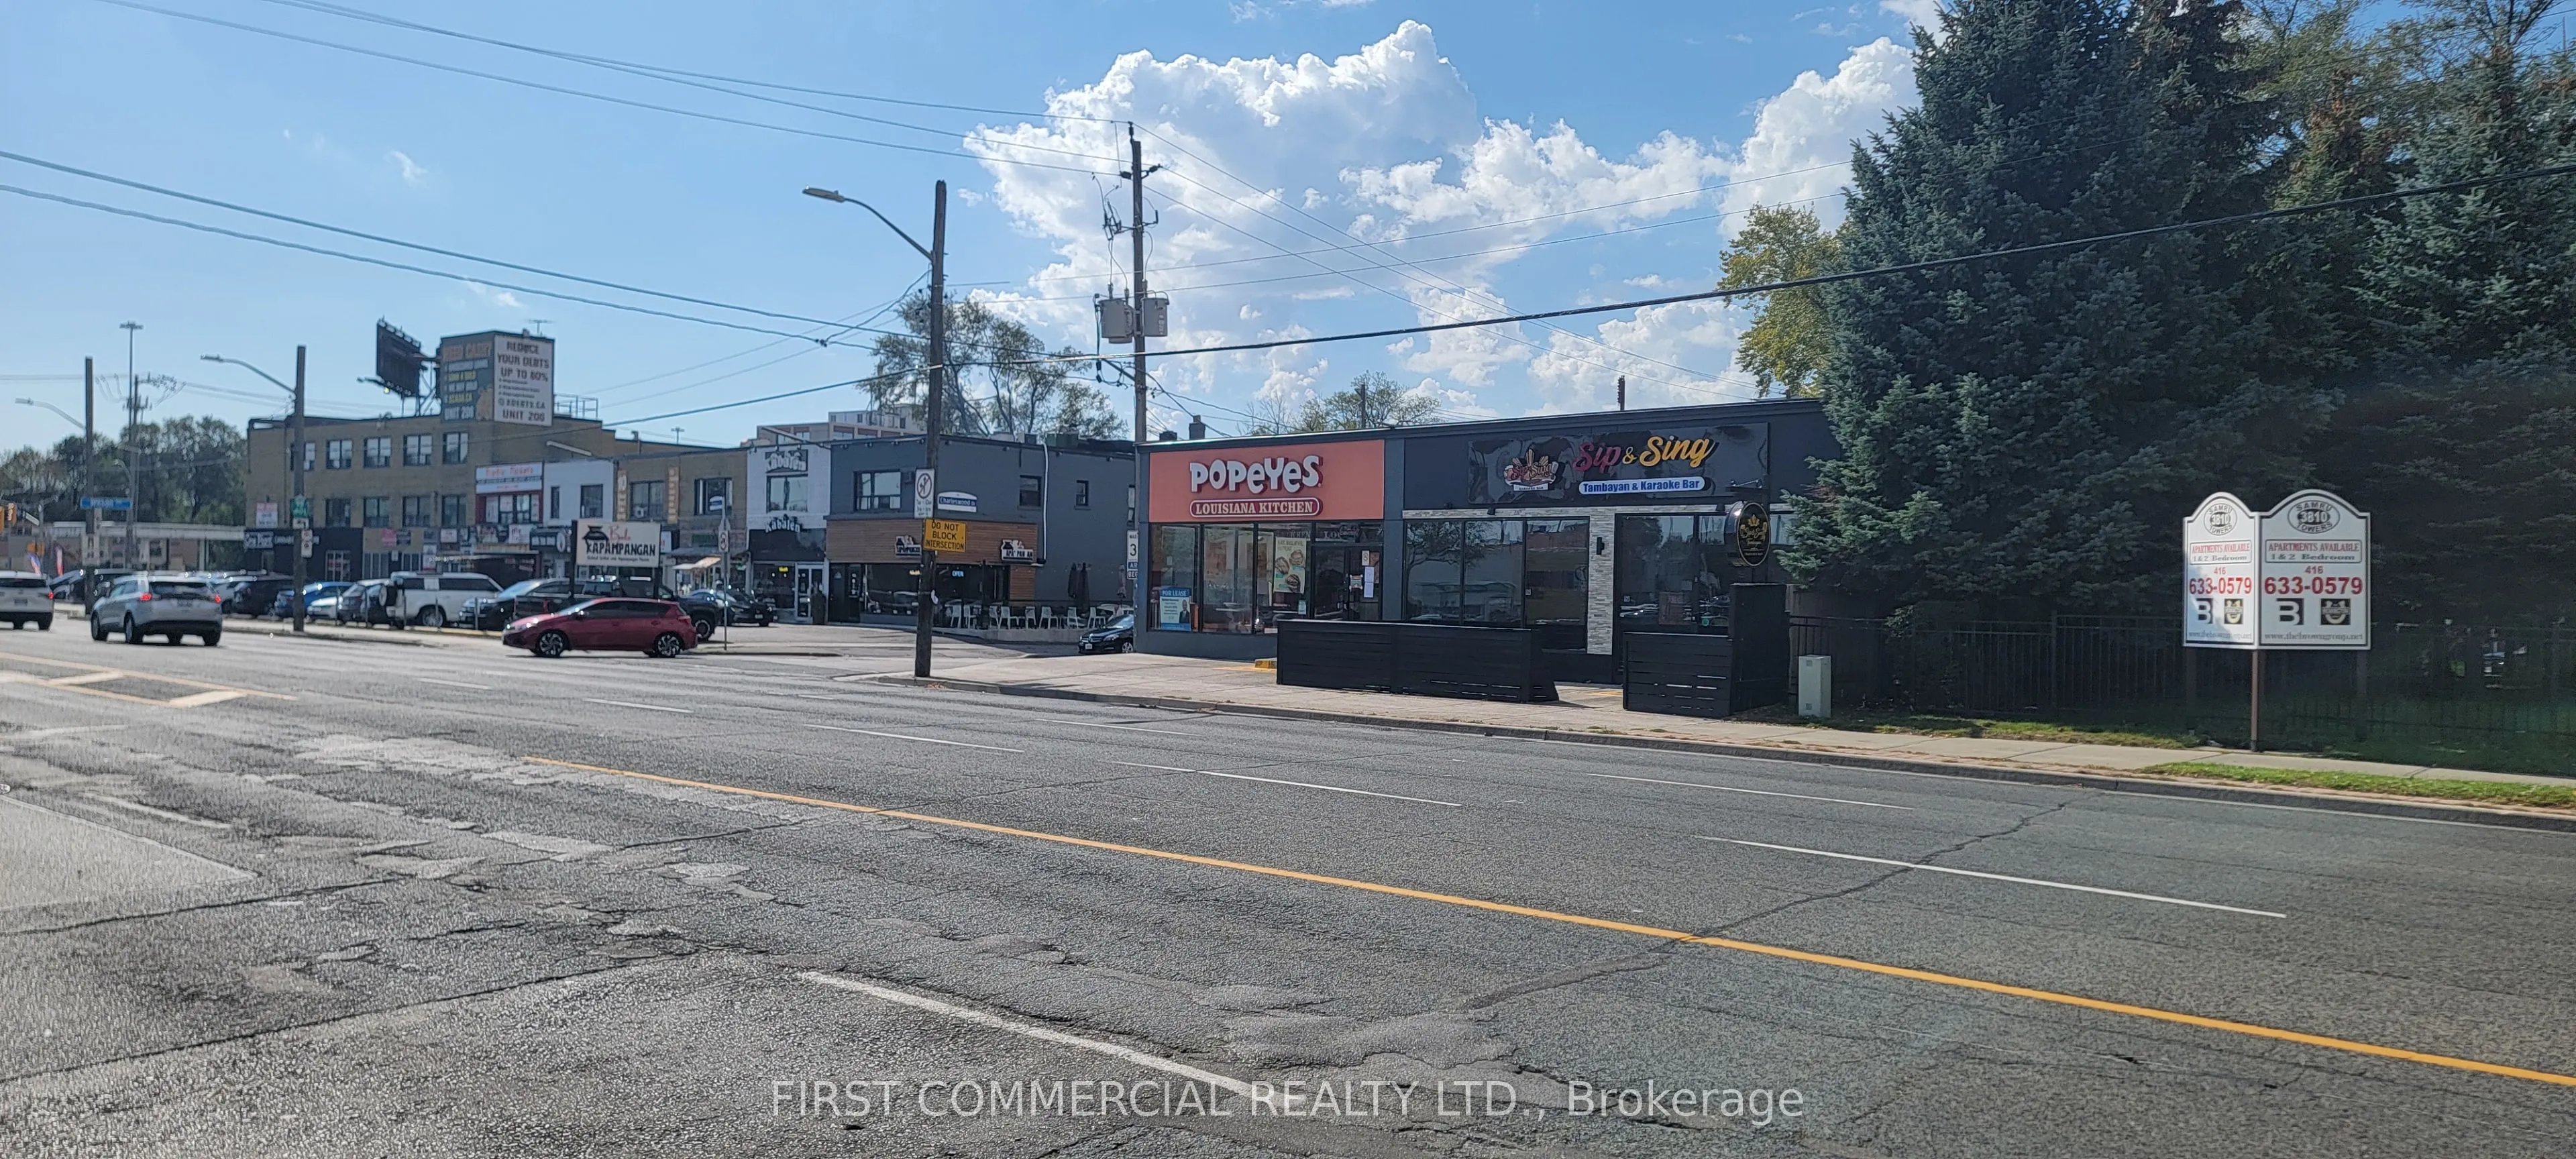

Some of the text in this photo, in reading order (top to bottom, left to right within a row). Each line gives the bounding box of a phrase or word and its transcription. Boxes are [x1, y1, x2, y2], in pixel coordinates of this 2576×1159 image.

[497, 353, 521, 366] YOUR
[523, 357, 549, 368] DEBTS
[500, 367, 513, 378] UP
[516, 368, 527, 379] TO
[502, 408, 523, 421] UNIT
[1572, 436, 1715, 474] Sip & Sing
[1583, 480, 1700, 493] Tambayan & Karaoke Bar
[1195, 501, 1313, 515] LOUISIANA KITCHEN
[2208, 505, 2233, 514] SAMRU
[2296, 502, 2333, 512] SAMRU
[2211, 514, 2231, 525] 3810
[2301, 511, 2328, 522] 3810
[932, 521, 941, 529] DO
[2210, 525, 2233, 534] TOWERS
[2296, 521, 2332, 532] TOWERS
[932, 531, 957, 540] BLOCK
[586, 542, 655, 556] KAPAMPANGAN
[926, 540, 964, 550] INTERSECTION
[1130, 543, 1137, 557] 3
[2192, 543, 2250, 554] APARTMENTS AVAILABLE
[2269, 543, 2359, 552] APARTMENTS AVAILABLE
[2214, 567, 2226, 575] 416
[2304, 566, 2324, 574] 416
[2190, 577, 2252, 595] 633-0579
[2264, 576, 2363, 595] 633-0579
